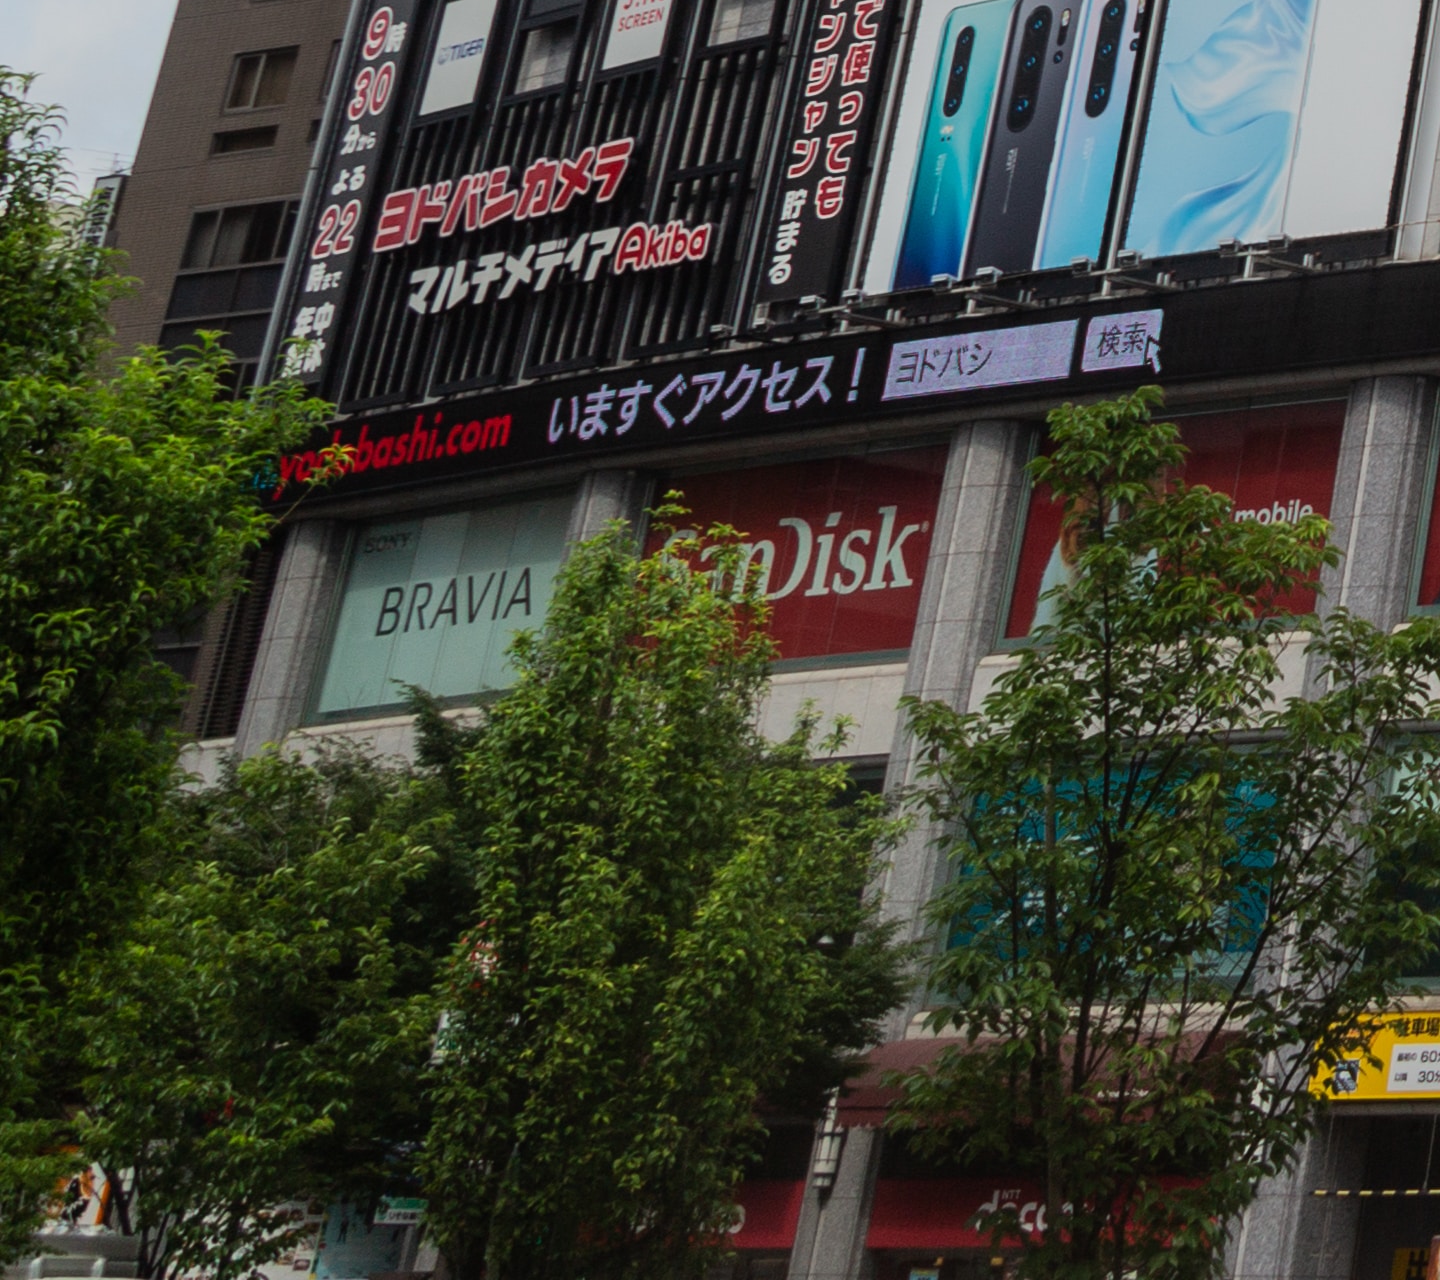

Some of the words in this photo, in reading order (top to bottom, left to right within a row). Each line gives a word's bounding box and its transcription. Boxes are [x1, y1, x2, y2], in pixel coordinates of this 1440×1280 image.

[617, 7, 665, 33] SCREEN
[450, 38, 485, 62] TIGER
[347, 61, 397, 122] 30
[331, 164, 367, 196] よる
[370, 137, 638, 254] ヨドバシカメラ
[311, 198, 363, 260] 22
[405, 227, 618, 316] マルチメディア
[612, 220, 712, 276] Akiba
[1096, 320, 1149, 362] 検索
[361, 531, 415, 558] SONY
[376, 565, 534, 639] BRAVIA
